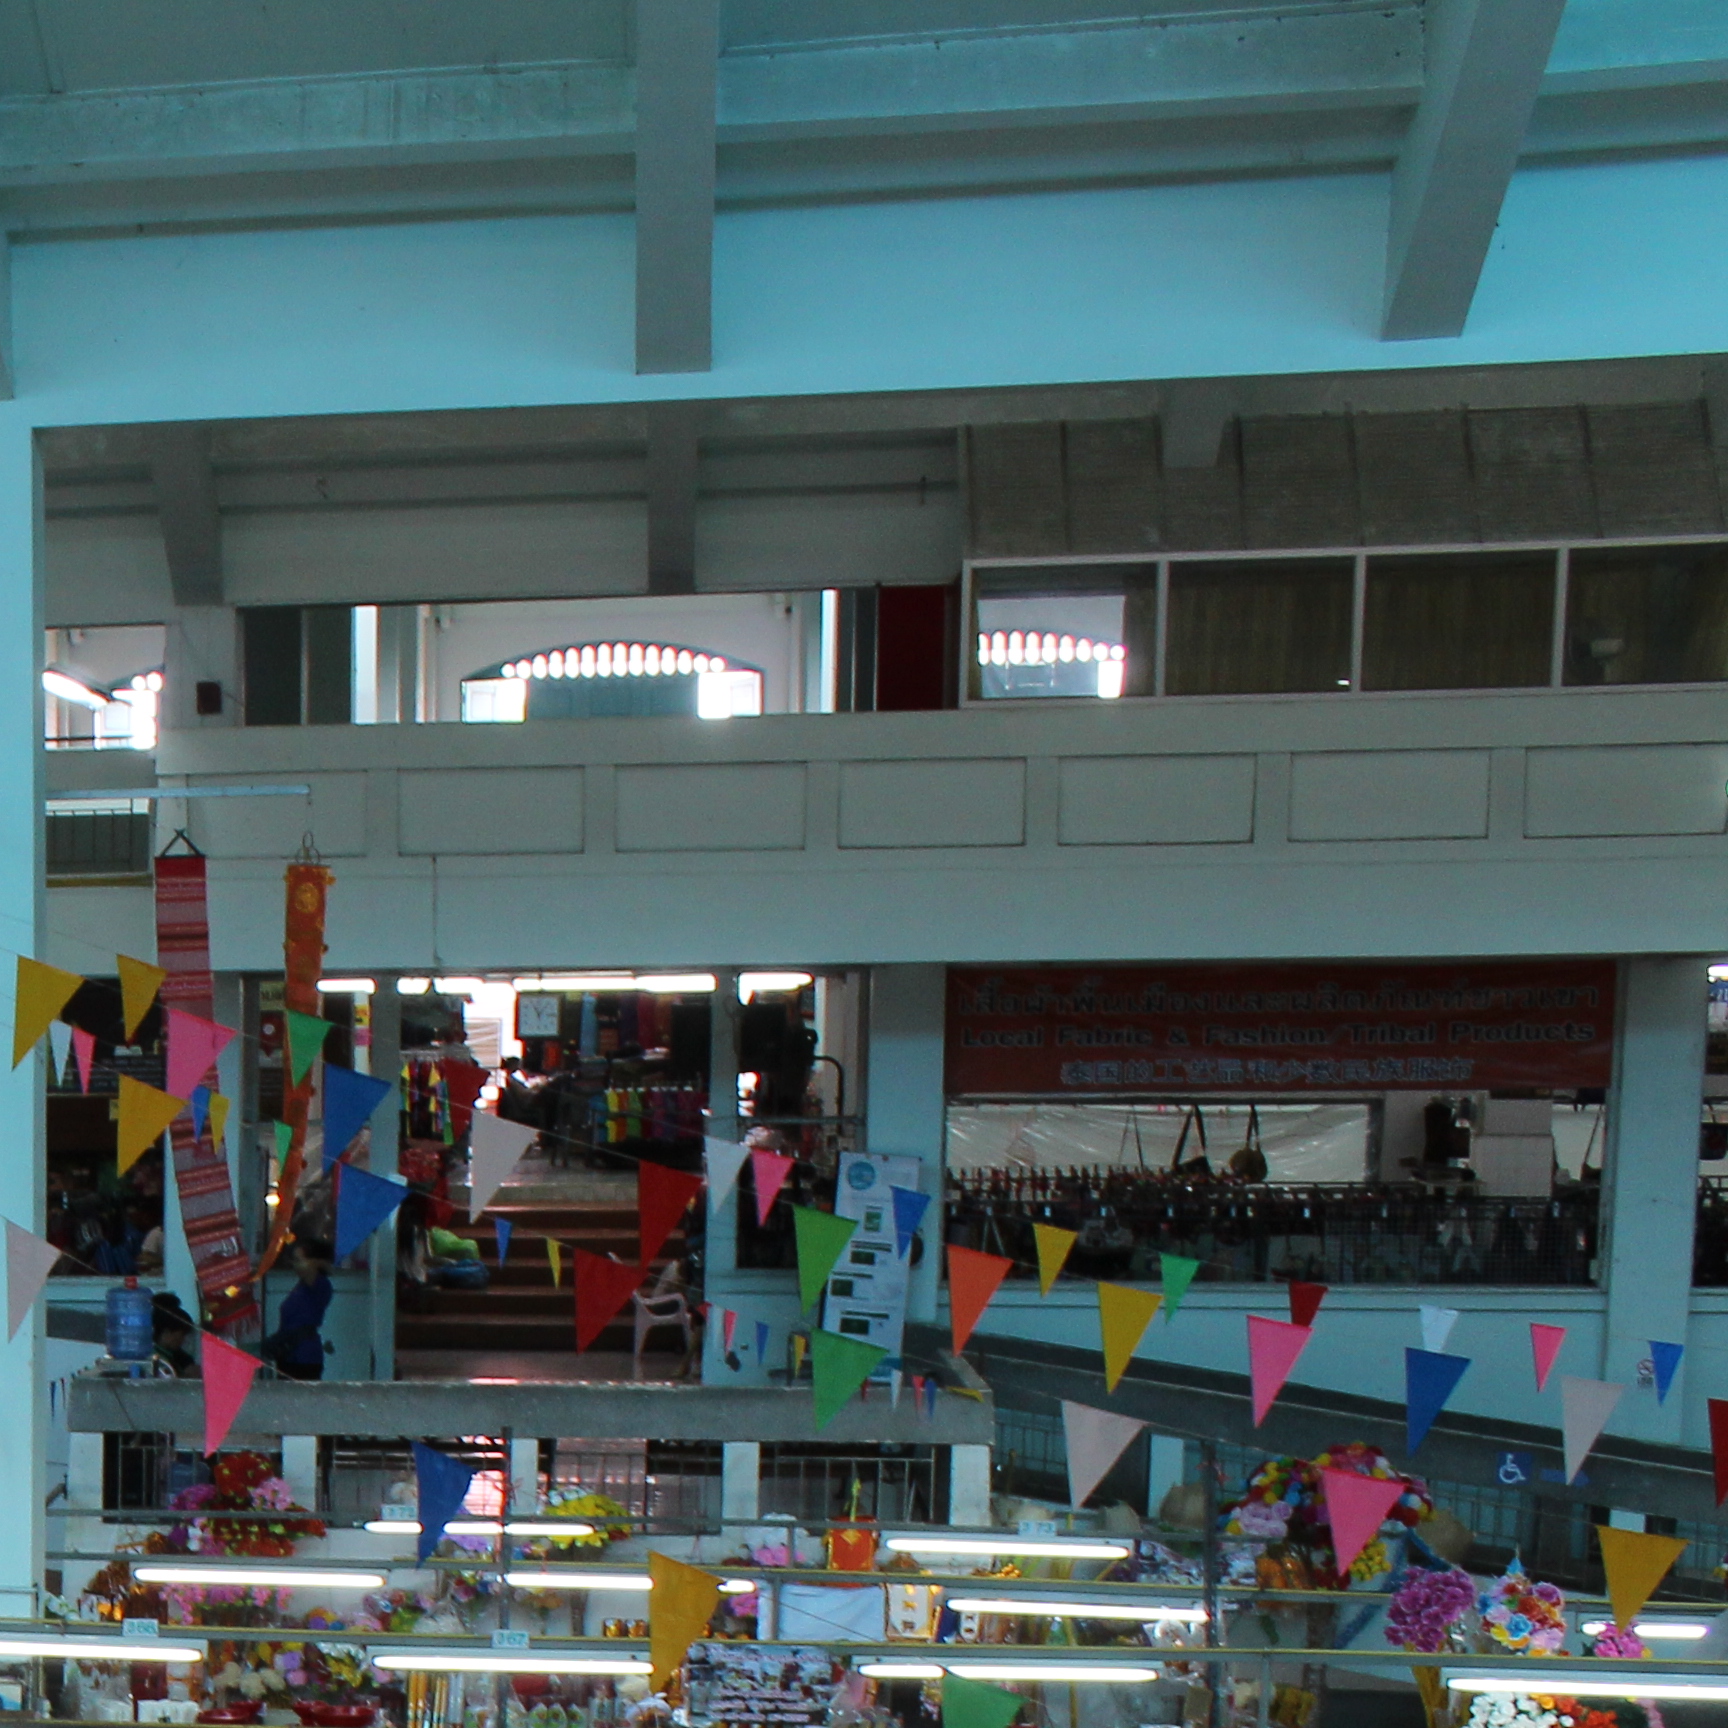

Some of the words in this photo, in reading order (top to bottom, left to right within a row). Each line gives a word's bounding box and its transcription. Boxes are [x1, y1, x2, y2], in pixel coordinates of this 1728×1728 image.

[961, 1026, 1044, 1048] Local
[1055, 1025, 1154, 1048] Fabric
[1166, 1026, 1190, 1046] &
[1448, 1021, 1596, 1043] Products
